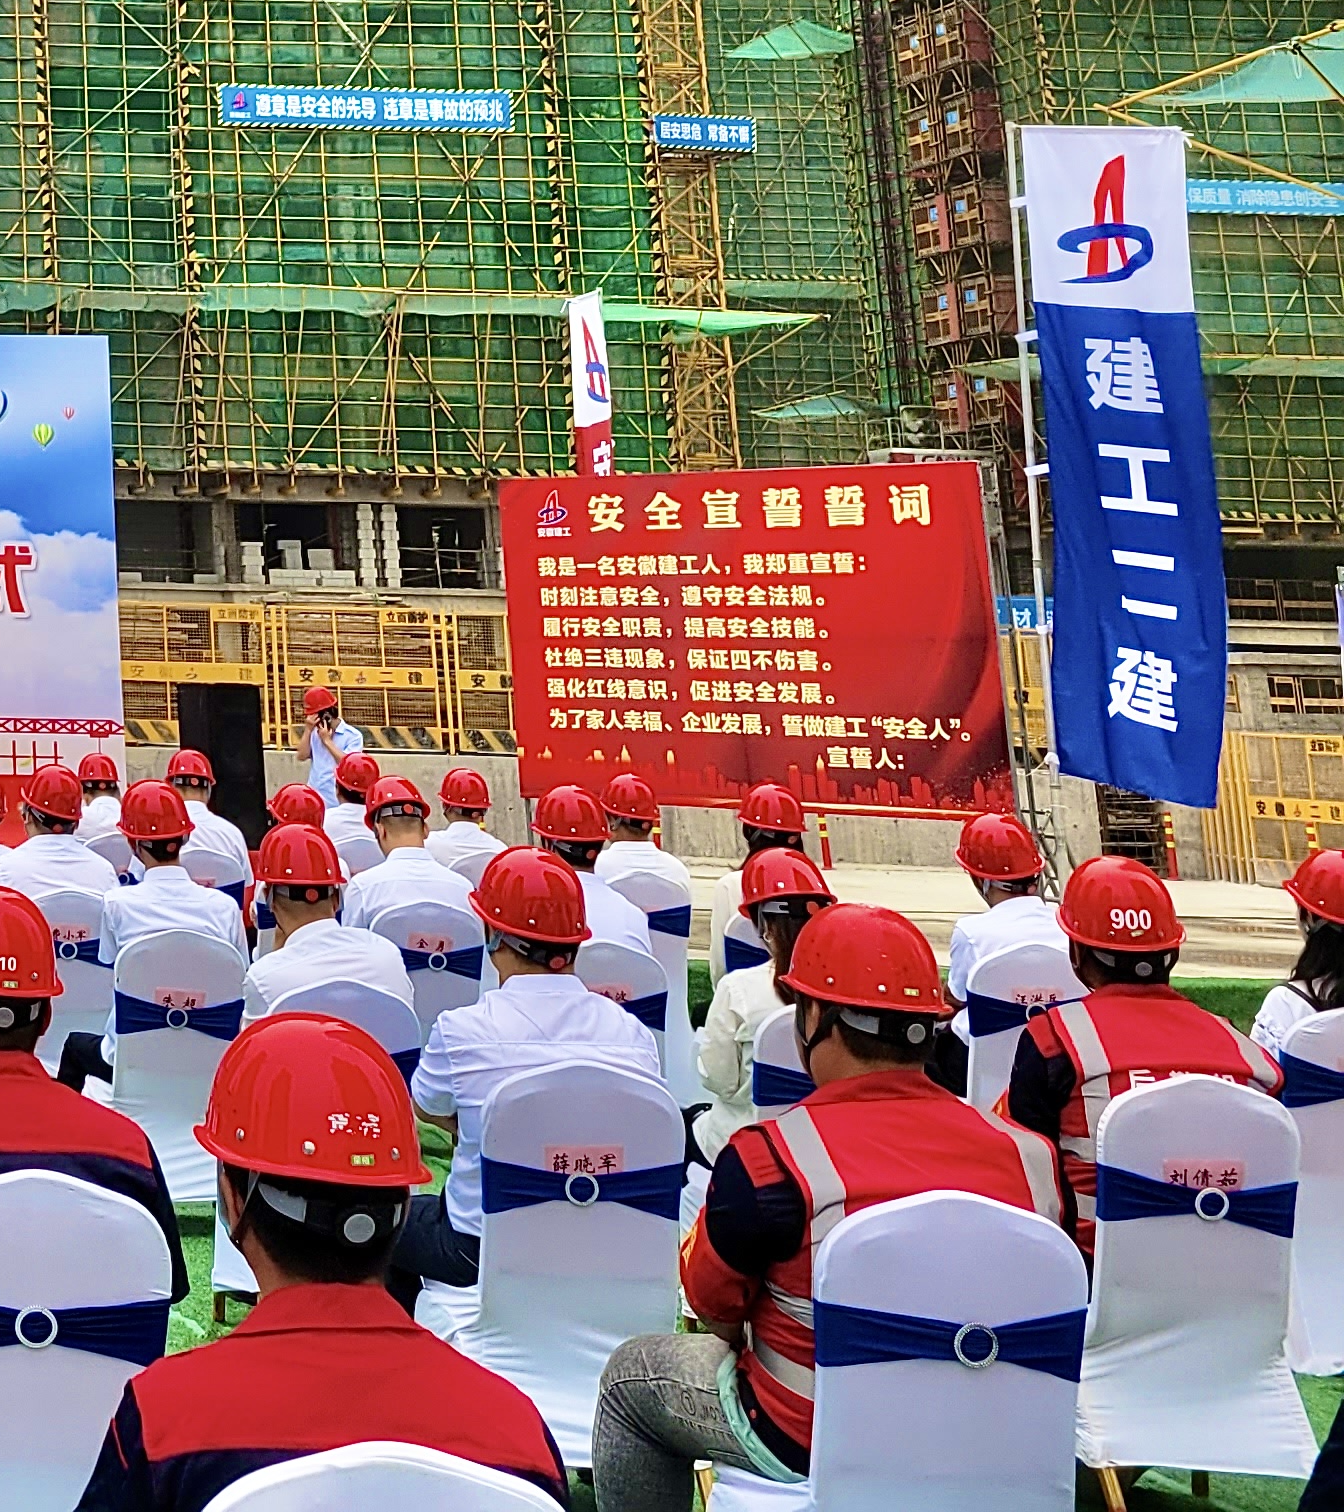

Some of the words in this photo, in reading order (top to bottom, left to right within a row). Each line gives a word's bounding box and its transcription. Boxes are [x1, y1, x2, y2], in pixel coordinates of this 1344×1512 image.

[255, 93, 376, 120] 遵章是安全的先导
[383, 95, 503, 123] 违章是事故的预兆
[660, 121, 701, 141] 居安思危
[587, 484, 932, 532] 安全宣誓誓词
[1084, 337, 1180, 733] 建工二建
[537, 553, 866, 578] 我是一名安徽建工人，我郑重宣誓：
[540, 585, 826, 608] 时刻注意安全，遵守安全法规。
[543, 616, 829, 640] 履行安全职责，提高安全技能。
[544, 648, 832, 673] 杜绝三违现象，保证四不伤害。
[547, 678, 836, 704] 强化红线意识，促进安全发展。
[1110, 908, 1152, 931] 900
[0, 956, 17, 971] 10
